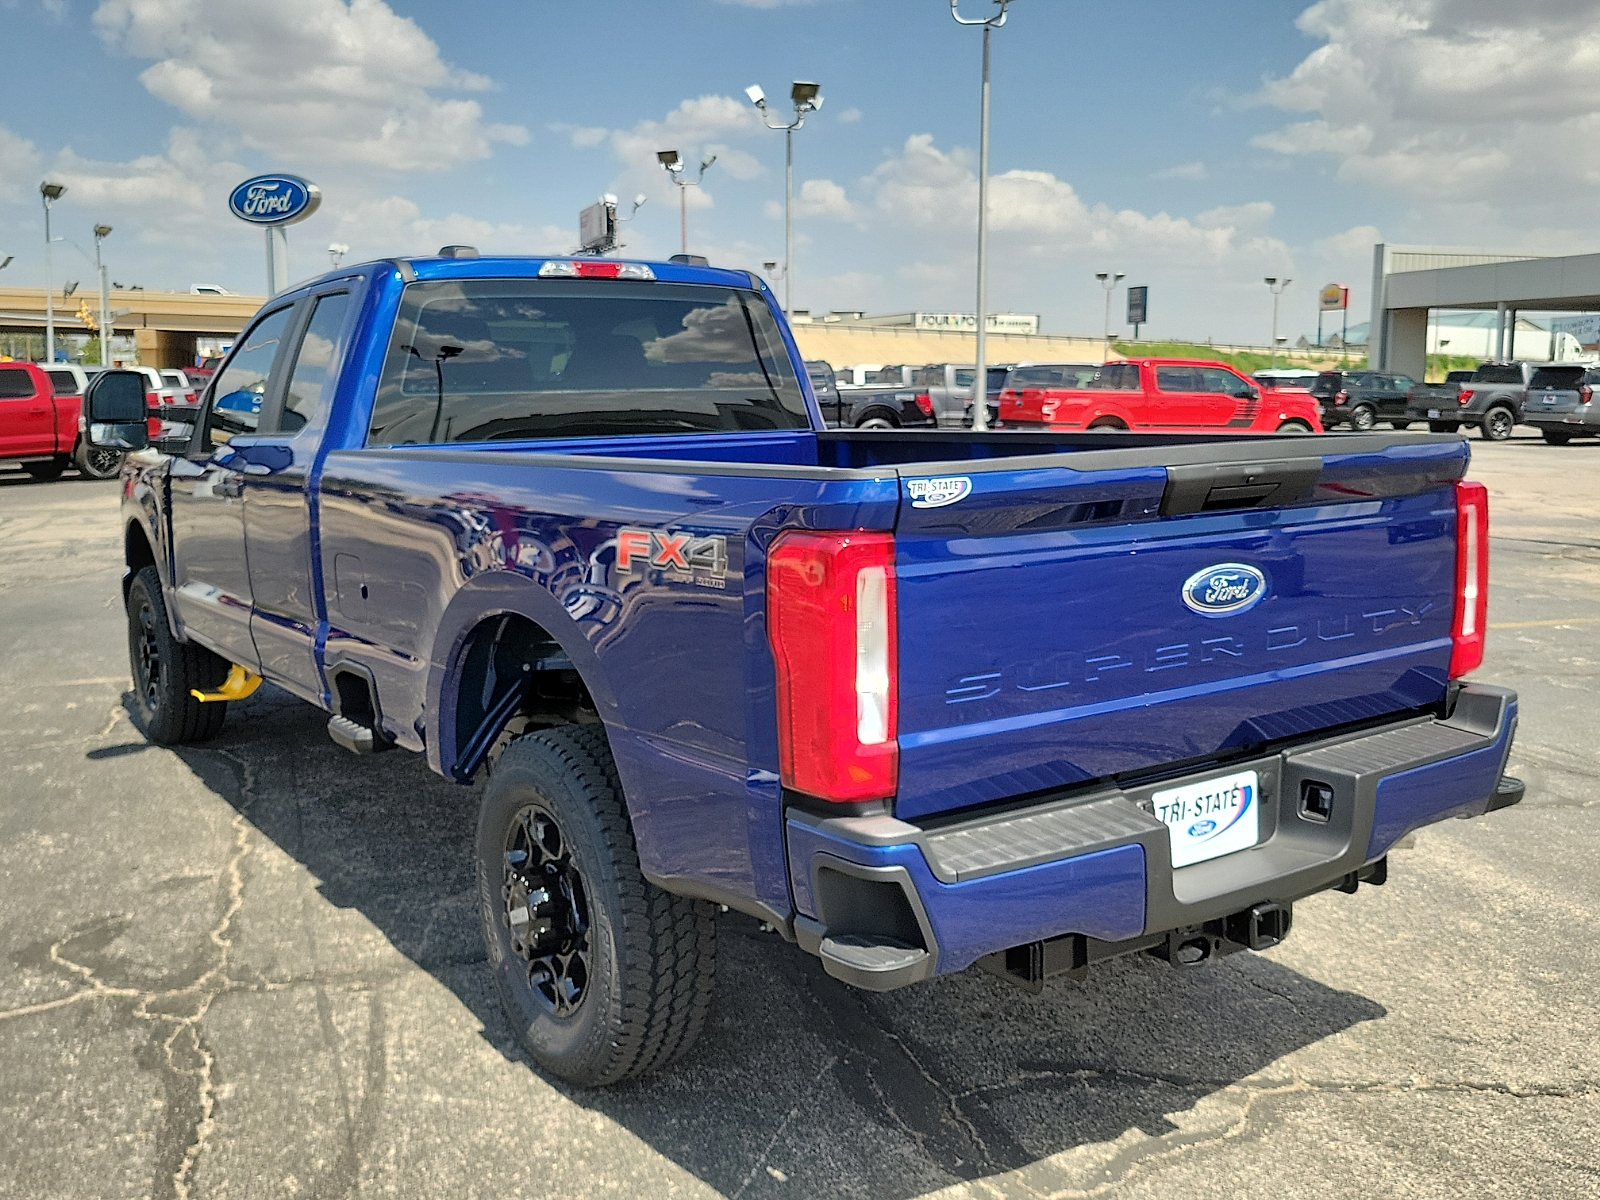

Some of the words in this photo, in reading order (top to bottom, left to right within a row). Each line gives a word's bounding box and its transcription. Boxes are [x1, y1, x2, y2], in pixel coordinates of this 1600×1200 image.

[243, 182, 292, 215] Ford
[921, 315, 950, 327] FOUR
[961, 316, 998, 327] POTS
[911, 481, 959, 495] TRI-STATE
[616, 526, 728, 578] FX4
[1205, 574, 1250, 603] Ford
[945, 636, 1244, 705] SUPER
[1266, 602, 1433, 652] DUTY
[1159, 785, 1240, 823] TRI-STATE
